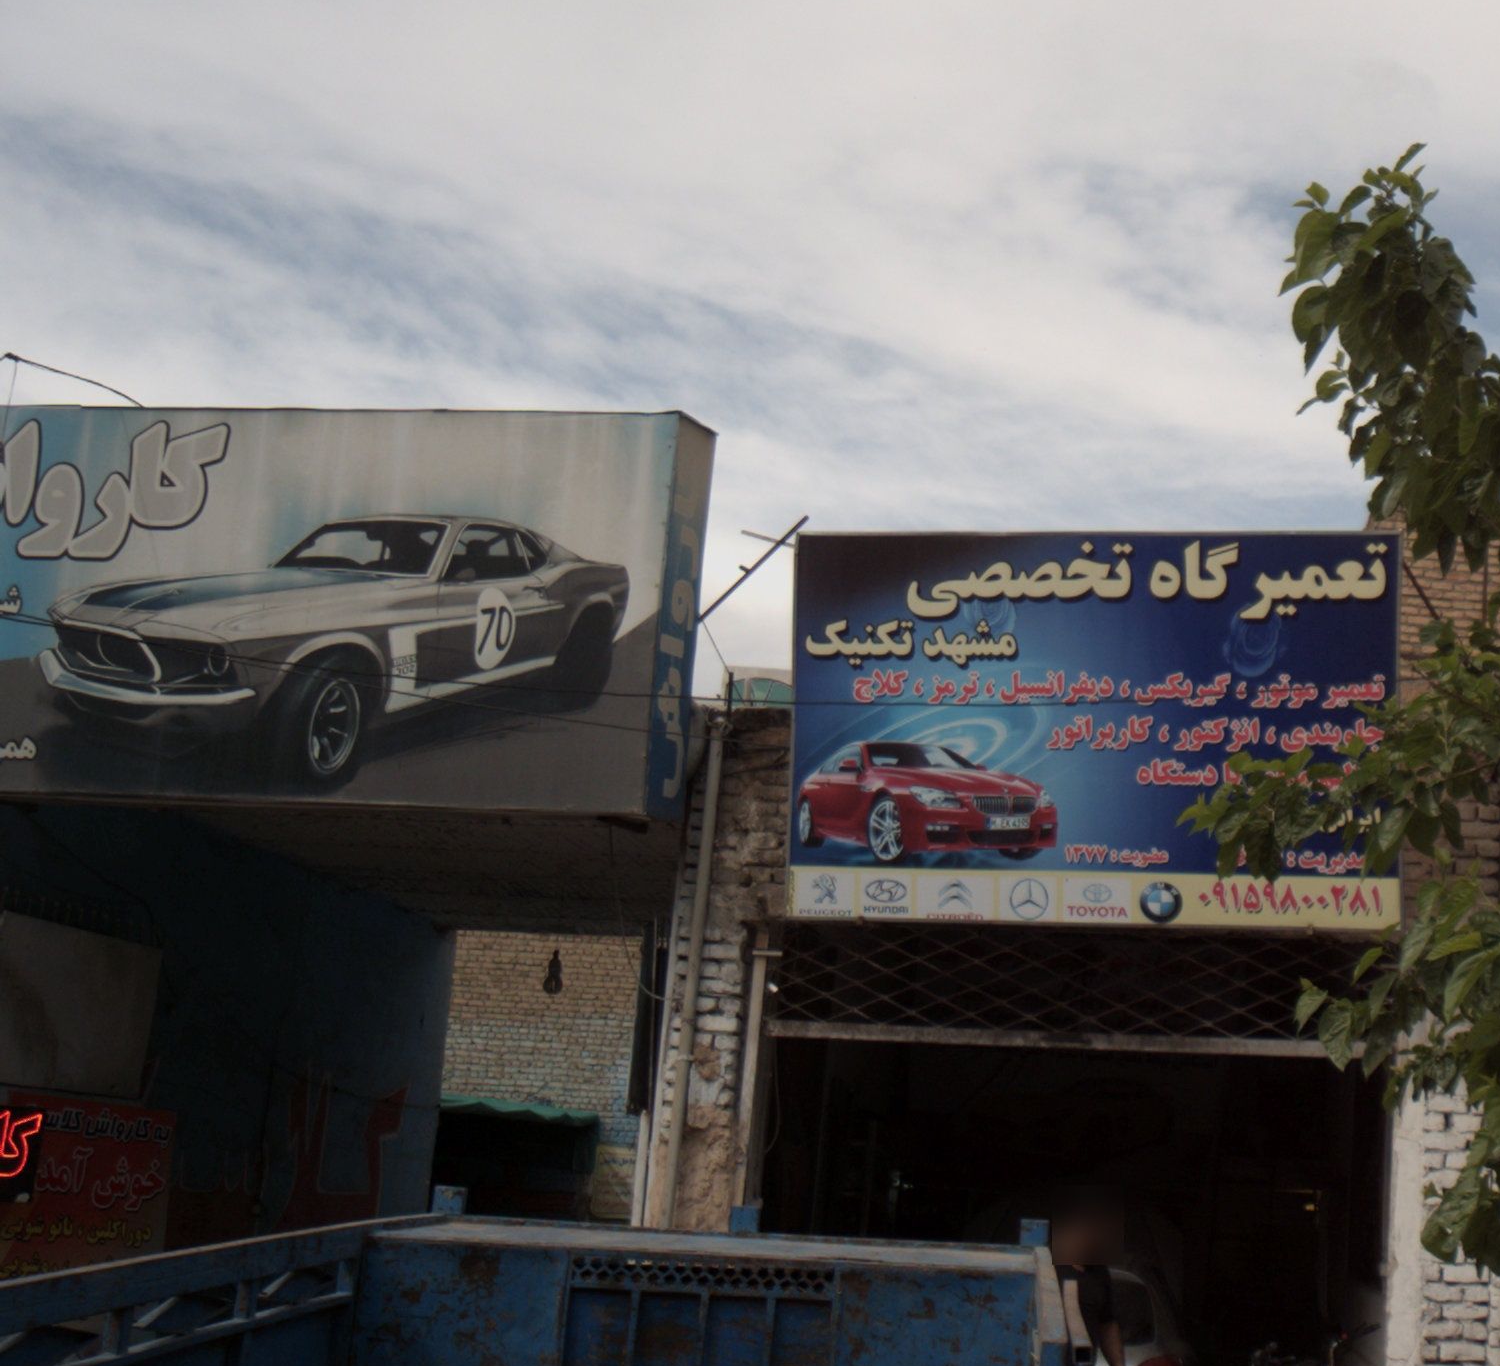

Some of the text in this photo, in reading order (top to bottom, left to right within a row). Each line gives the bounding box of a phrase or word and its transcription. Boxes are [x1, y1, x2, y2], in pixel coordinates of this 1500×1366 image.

[0, 419, 231, 560] کاروا
[906, 540, 1134, 617] تخصصی
[477, 605, 514, 656] 70
[659, 487, 703, 801] ارواش
[805, 618, 1017, 666] مشهد تکنیک
[853, 670, 1386, 708] تعمیر موتور گیربکس دیفرانسیل ترمز کلاچ
[1046, 716, 1154, 751] کاربراتور
[1137, 758, 1218, 786] دستگاه
[1064, 843, 1107, 864] ۱۳۷۷
[862, 905, 910, 915] HYUNDAI
[1067, 905, 1128, 918] TOYOTA
[1198, 881, 1383, 916] ۰۹۱۵۹۸۰۰۲۸۱
[45, 1107, 84, 1133] کلاس
[85, 1107, 152, 1144] کارواش
[35, 1146, 166, 1212] خوش آمد
